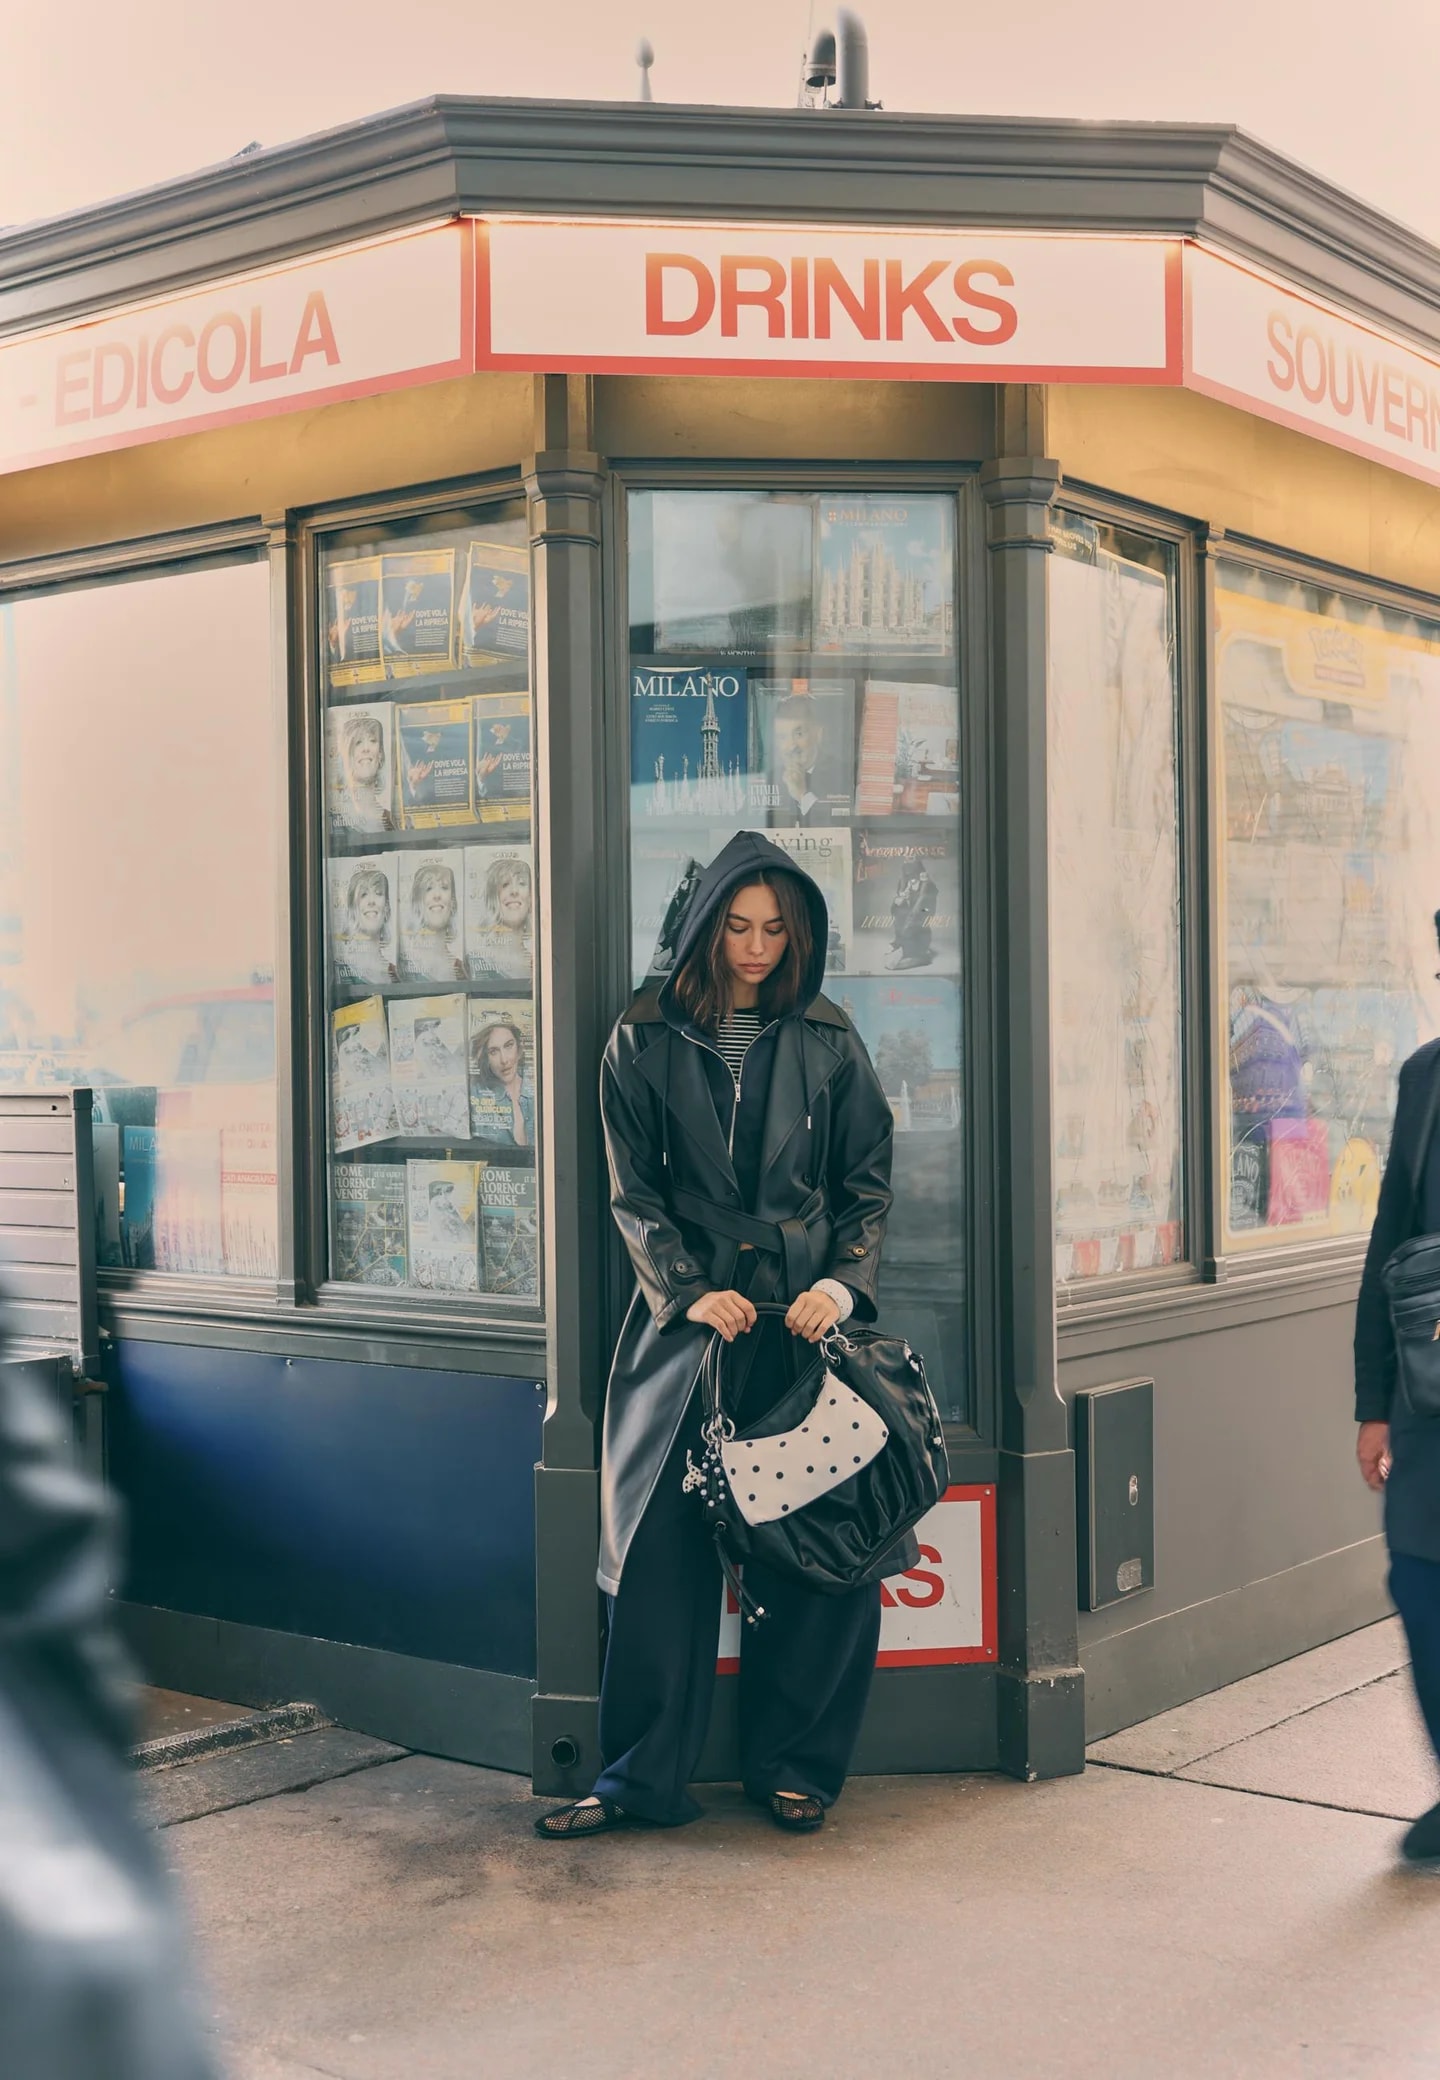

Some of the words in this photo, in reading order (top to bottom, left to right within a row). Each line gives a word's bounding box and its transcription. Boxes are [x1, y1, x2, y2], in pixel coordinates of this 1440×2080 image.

[645, 252, 1018, 346] DRINKS
[54, 289, 341, 427] EDICOLA
[415, 609, 431, 618] DOVE
[431, 608, 448, 617] VOLA
[415, 619, 424, 627] LA
[424, 617, 449, 626] RIPRESA
[633, 676, 740, 698] MILANO
[434, 760, 450, 769] DOVE
[450, 759, 466, 767] VOLA
[503, 753, 520, 762] DOVE
[434, 769, 443, 777] LA
[443, 768, 468, 776] RIPRESA
[773, 833, 833, 857] iving
[334, 1165, 363, 1178] ROME
[334, 1177, 377, 1190] FLORENCE
[335, 1188, 369, 1200] VENISE
[480, 1193, 519, 1206] VENISE
